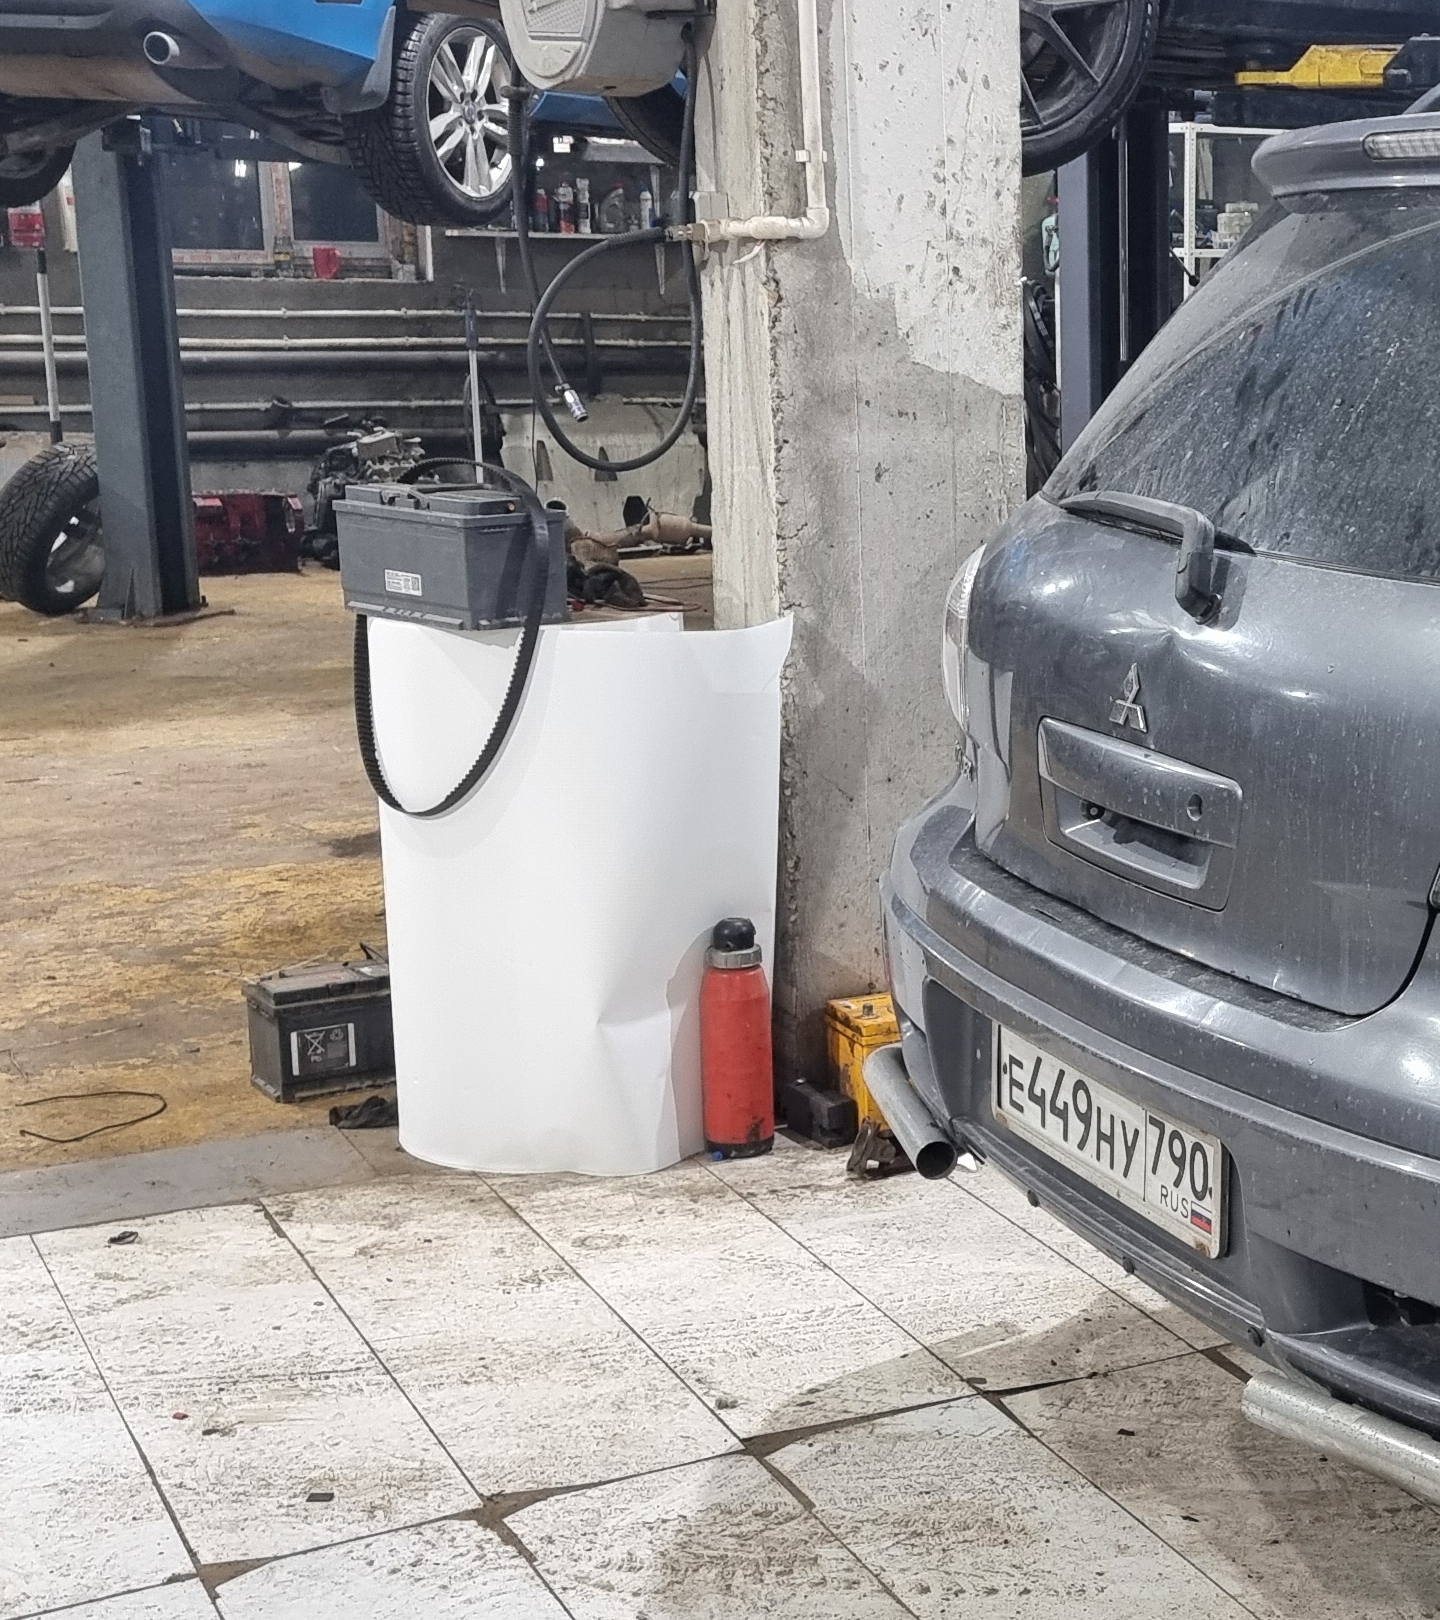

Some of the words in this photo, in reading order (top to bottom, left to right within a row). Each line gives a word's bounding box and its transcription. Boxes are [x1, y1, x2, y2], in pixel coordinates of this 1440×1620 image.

[1008, 1053, 1140, 1179] Е449НУ
[1148, 1113, 1209, 1201] 790
[1159, 1184, 1190, 1219] RUS
